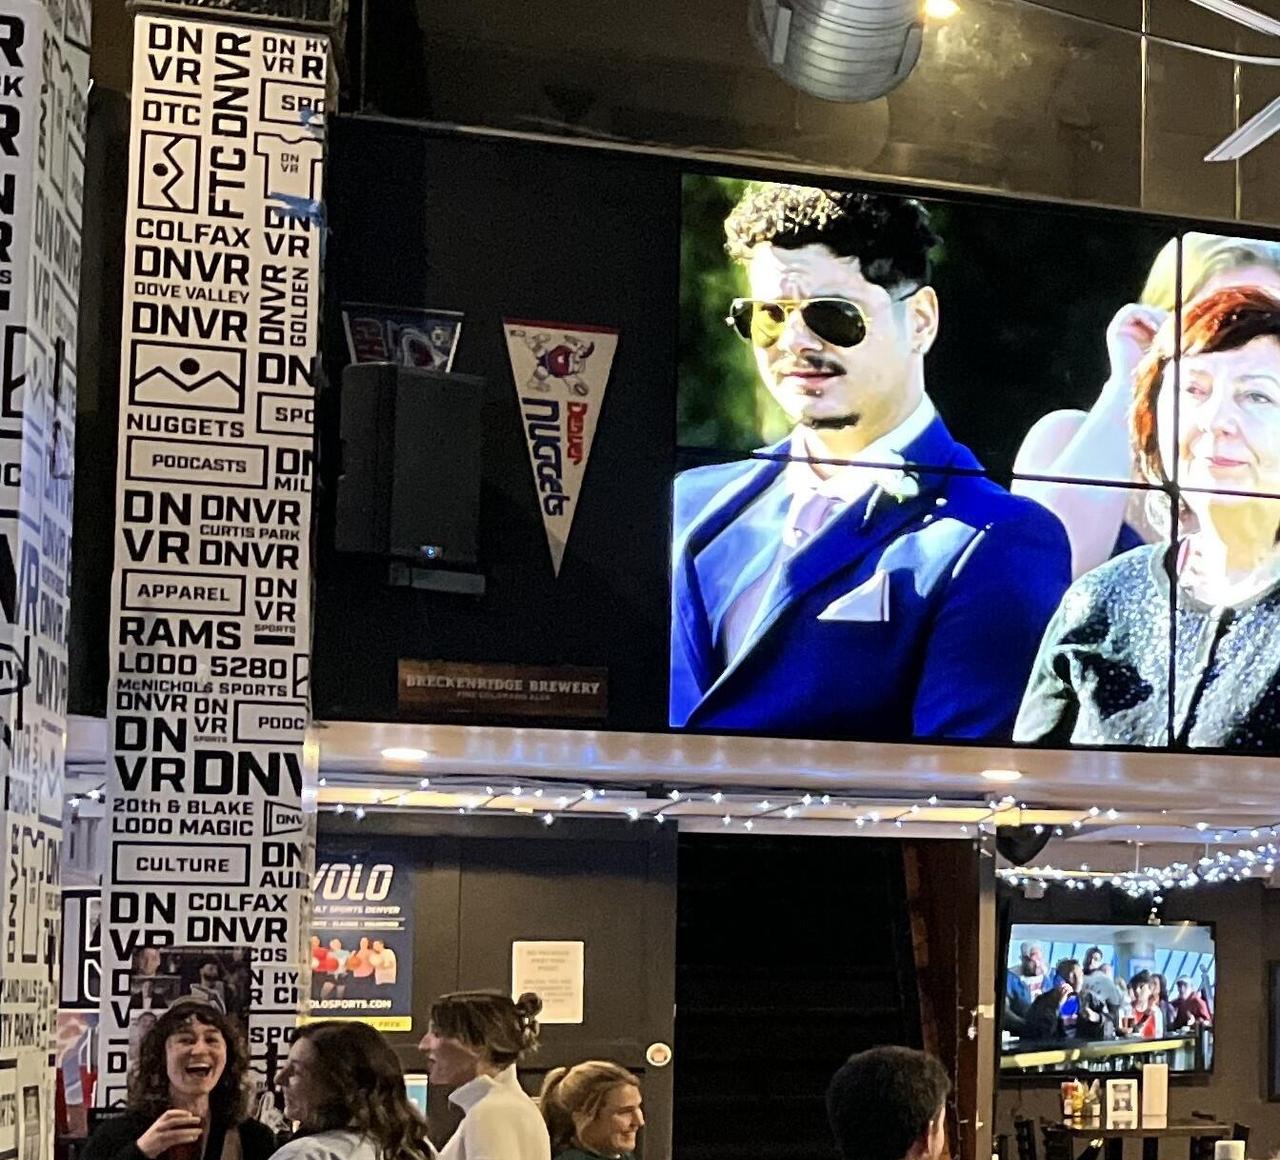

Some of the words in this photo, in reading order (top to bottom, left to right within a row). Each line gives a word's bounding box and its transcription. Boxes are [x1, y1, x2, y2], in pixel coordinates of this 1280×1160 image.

[262, 55, 295, 75] VR
[213, 31, 252, 137] DNVR
[143, 100, 200, 127] DTC
[209, 145, 246, 219] FTC
[136, 218, 250, 249] COLFAX
[135, 282, 180, 299] DOVE
[186, 286, 249, 304] VALLEY
[260, 265, 286, 346] DNVR
[291, 267, 310, 346] GOLDEN
[127, 414, 245, 439] NUGGETS
[152, 453, 247, 473] PODCASTS
[201, 495, 300, 526] DNVR
[200, 524, 254, 539] CURTIS
[259, 528, 300, 541] PARK
[138, 584, 230, 601] APPAREL
[255, 577, 297, 599] DN
[119, 616, 241, 650] RAMS
[254, 624, 296, 634] SPORTS
[119, 652, 197, 675] LODO
[211, 656, 287, 679] 5280
[117, 679, 213, 694] McNICHOLS
[219, 682, 287, 697] SPORTS
[406, 674, 523, 691] BRECKENRIDGE
[529, 680, 600, 694] BREWERY
[194, 697, 228, 715] DN
[115, 756, 186, 792] VR
[113, 800, 161, 815] 20th
[168, 801, 180, 814] &
[187, 801, 253, 816] BLAKE
[113, 817, 173, 835] LODO
[180, 818, 253, 836] MAGIC
[136, 857, 229, 872] CULTURE
[189, 893, 287, 912] COLFAX
[365, 906, 401, 915] DENVER
[309, 1000, 392, 1009] OLOSPORTS.COM
